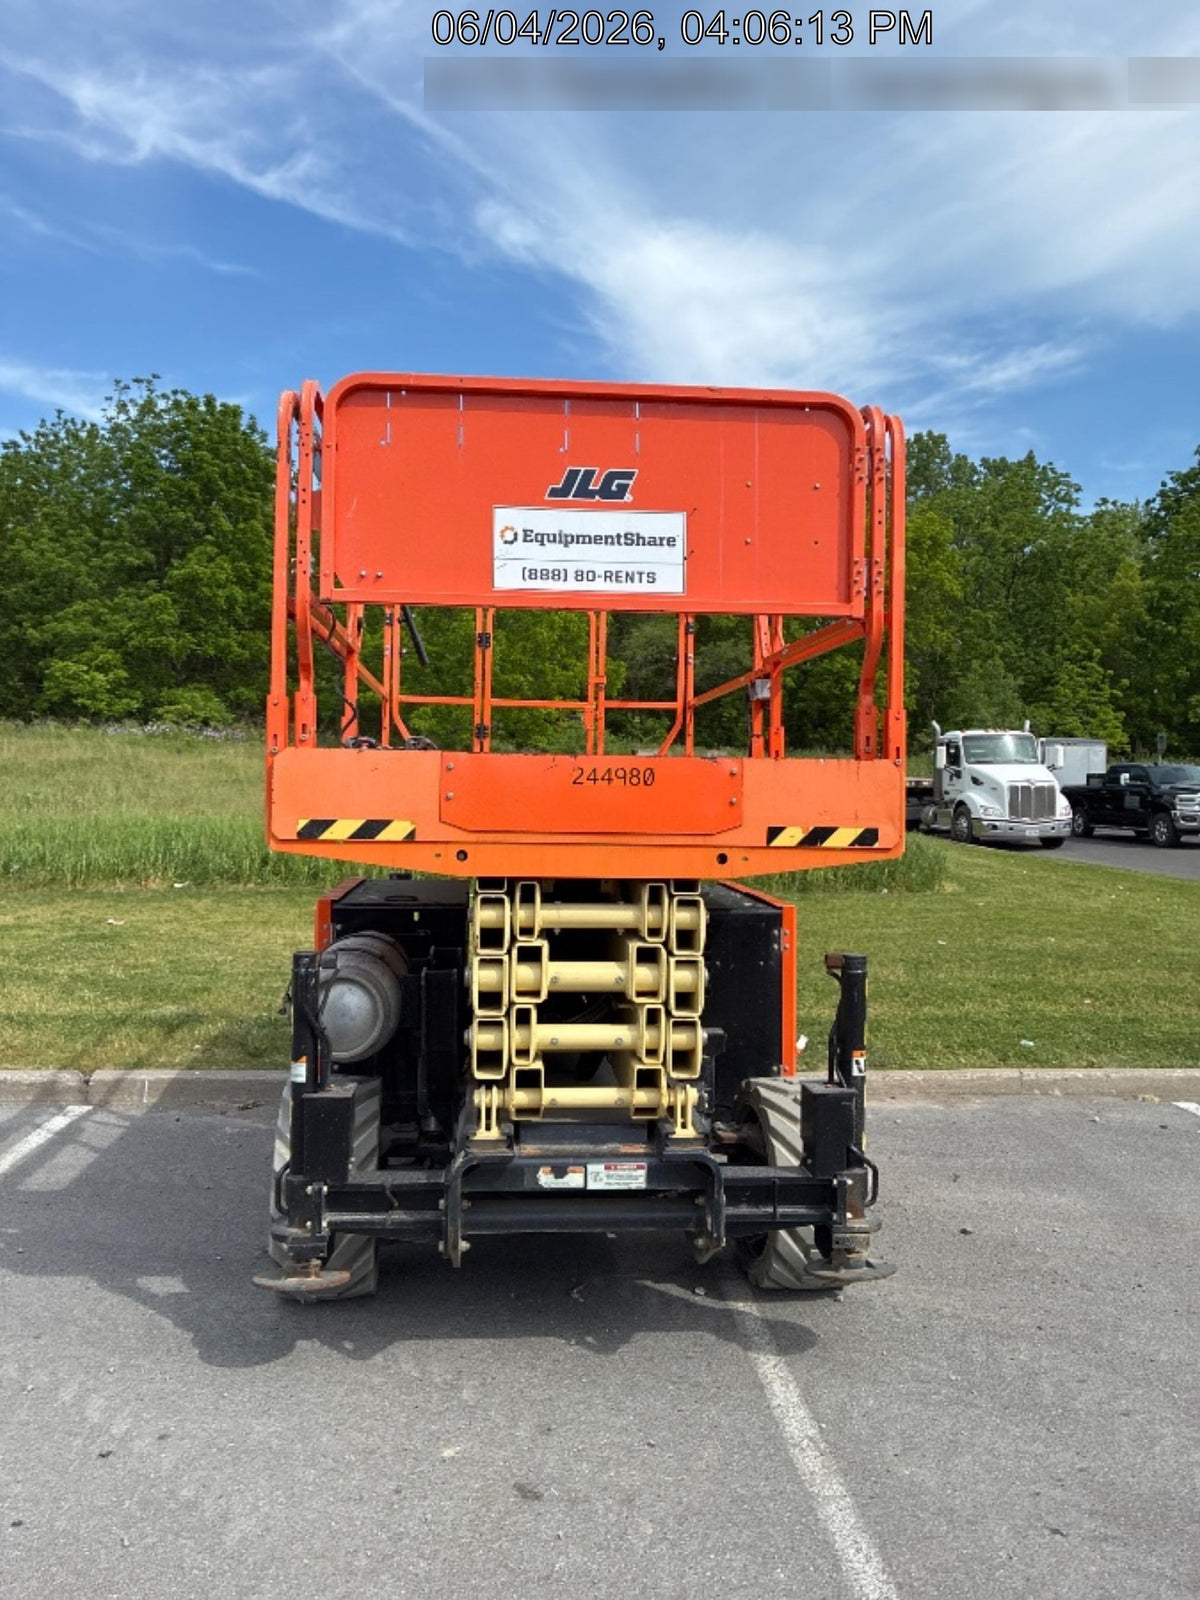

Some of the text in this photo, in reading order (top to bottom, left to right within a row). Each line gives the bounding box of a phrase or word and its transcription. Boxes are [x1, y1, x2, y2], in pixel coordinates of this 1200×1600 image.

[545, 467, 638, 502] JLG
[522, 529, 677, 548] EquipmentShare
[574, 569, 657, 584] 80-RENTS
[571, 767, 655, 786] 244980
